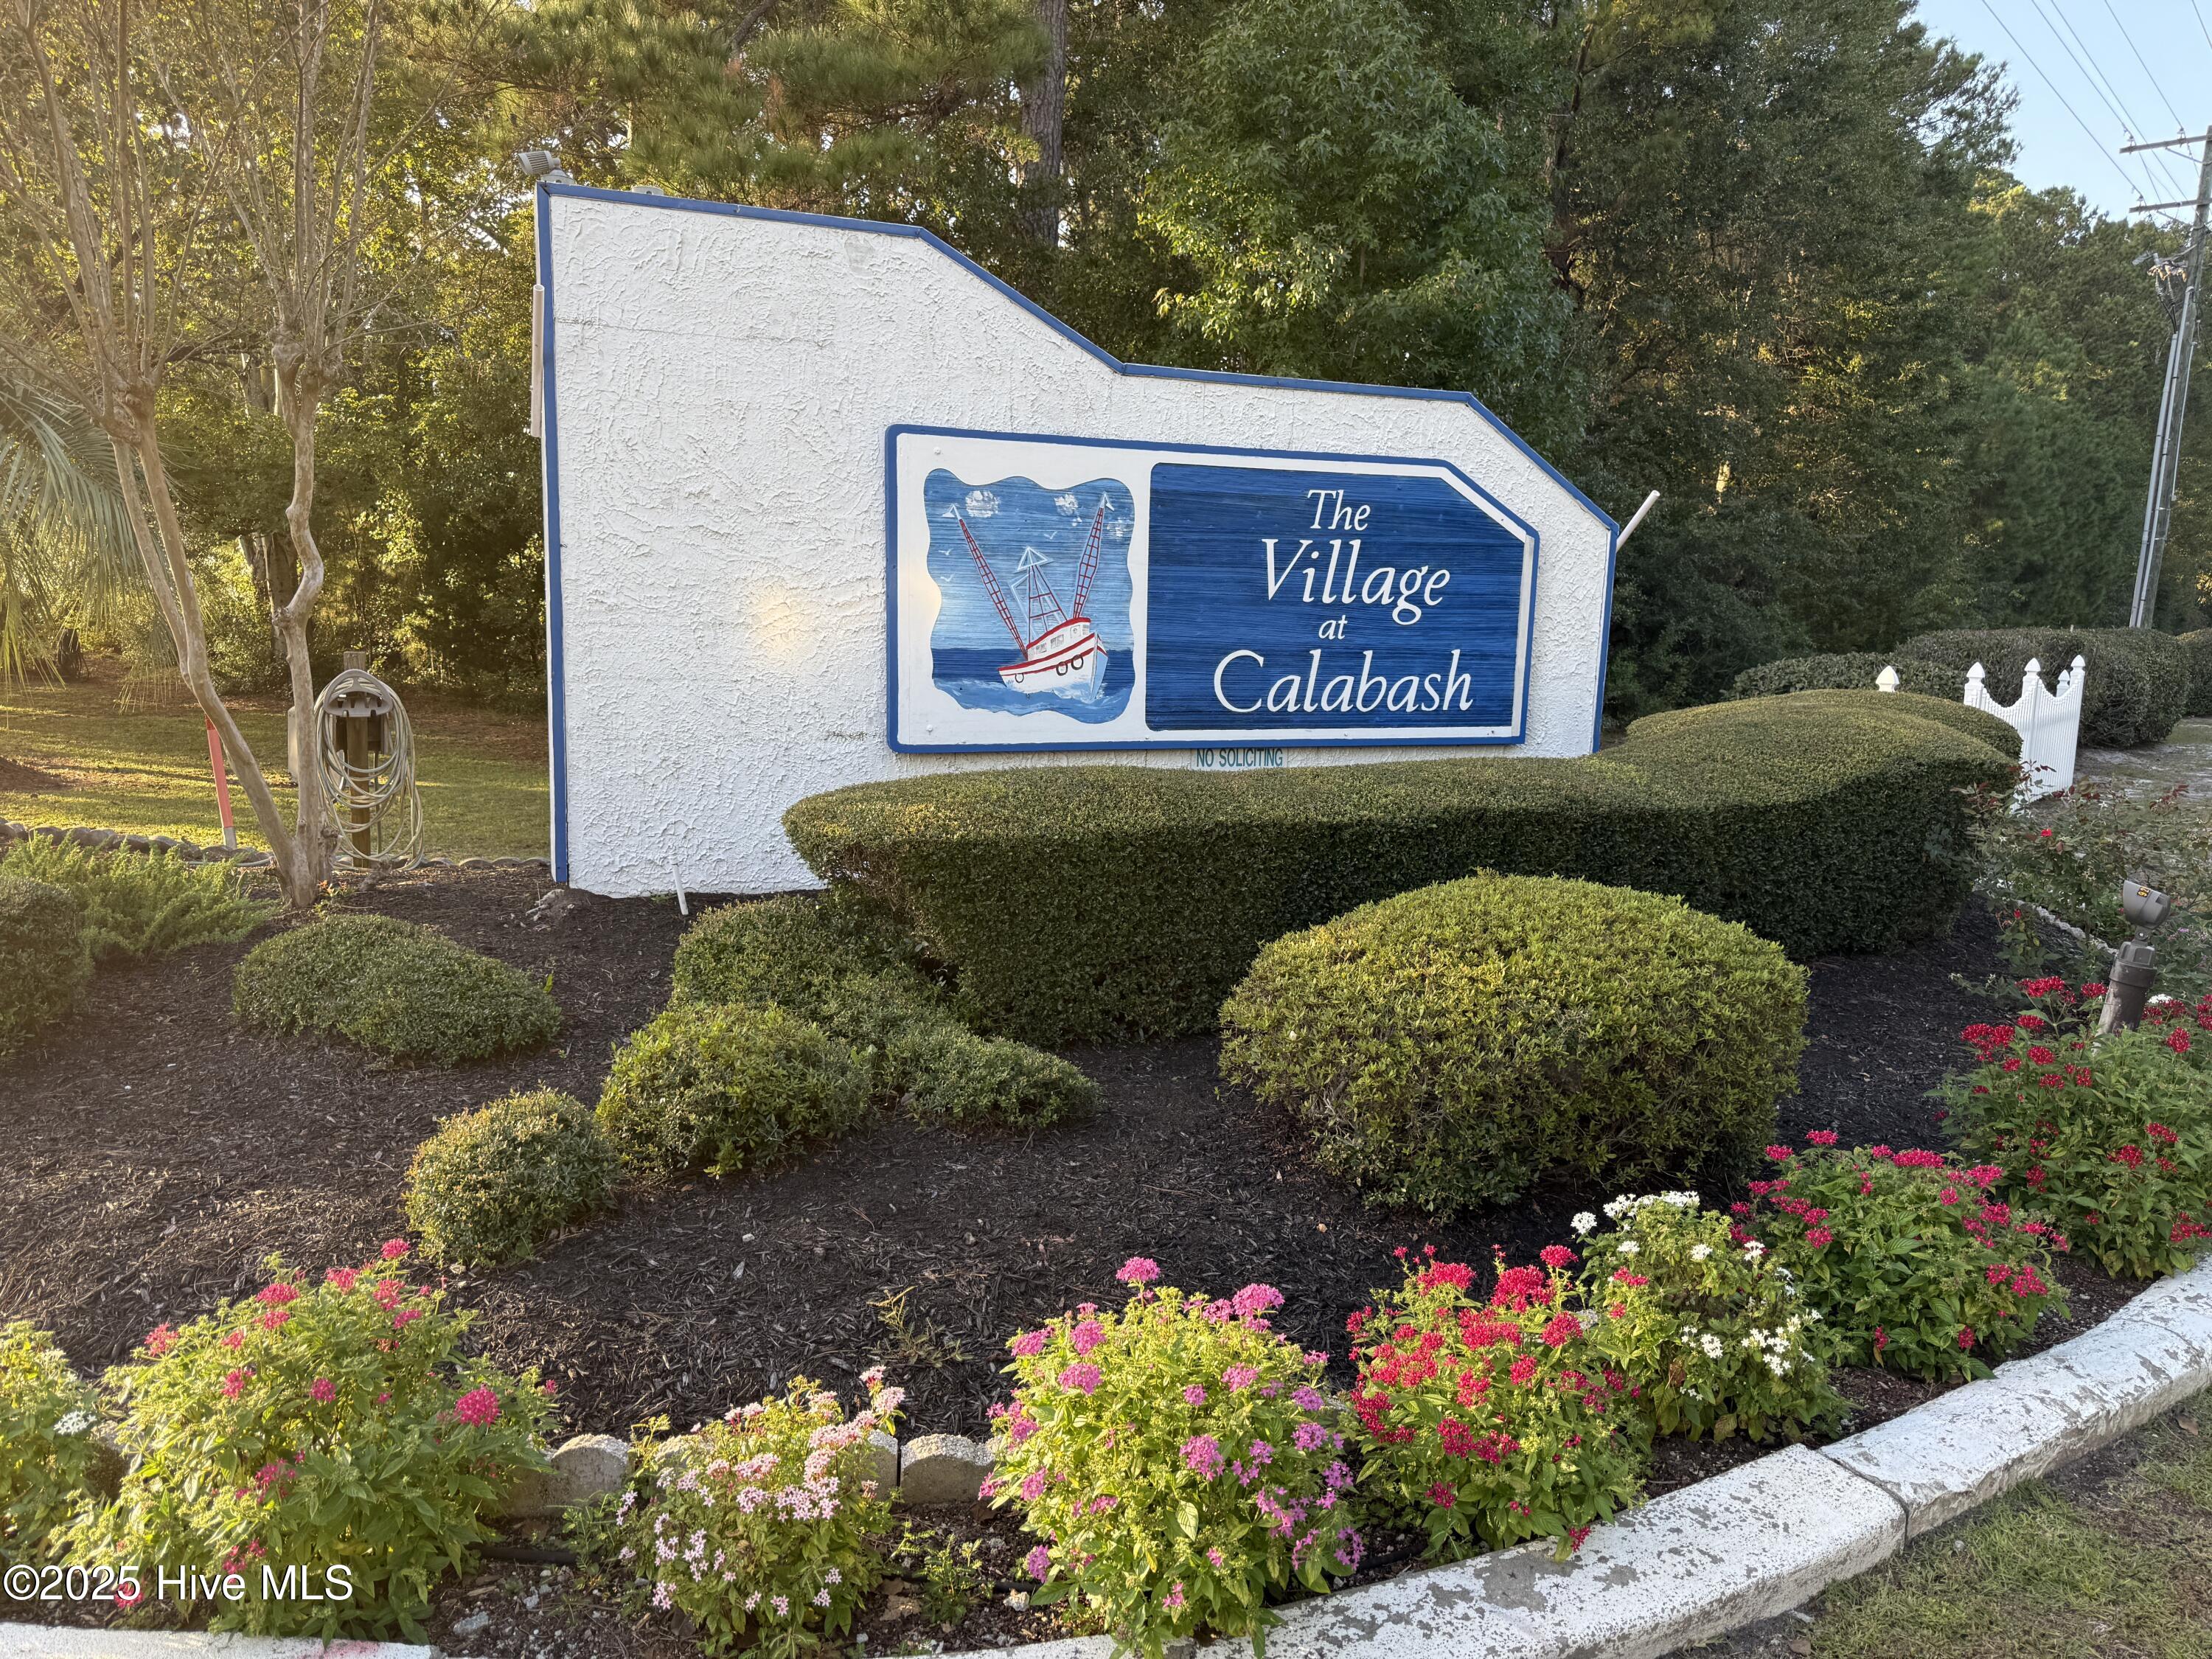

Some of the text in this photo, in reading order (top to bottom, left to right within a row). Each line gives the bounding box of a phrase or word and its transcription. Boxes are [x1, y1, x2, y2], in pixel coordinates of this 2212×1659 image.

[1307, 490, 1371, 531] The
[1262, 538, 1450, 625] Village
[1318, 614, 1348, 640] at
[1214, 649, 1473, 712] Calabash
[1196, 748, 1283, 768] NO SOLICITING
